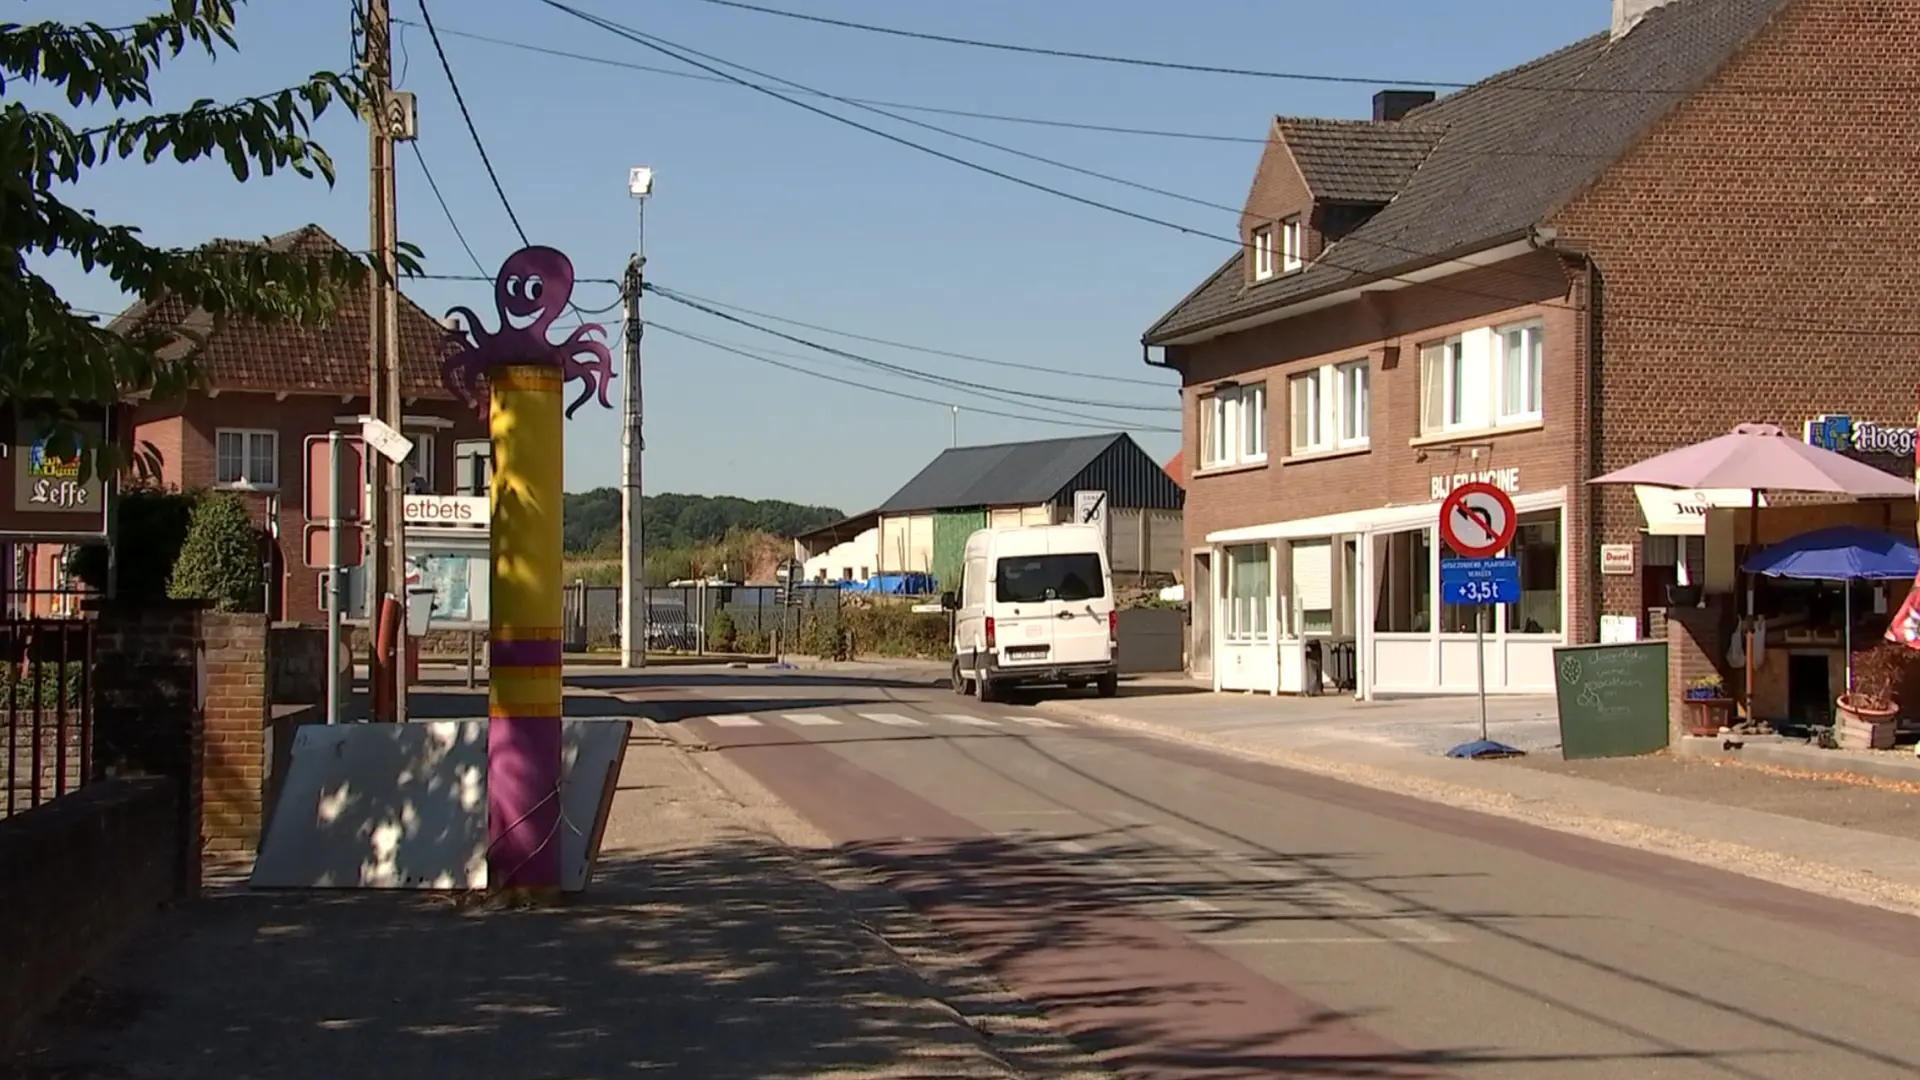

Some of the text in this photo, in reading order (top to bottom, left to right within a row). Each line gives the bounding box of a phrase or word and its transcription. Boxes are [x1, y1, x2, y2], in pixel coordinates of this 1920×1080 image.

[29, 479, 88, 508] Leffe
[1431, 474, 1450, 500] BIJ
[405, 499, 472, 519] etbets
